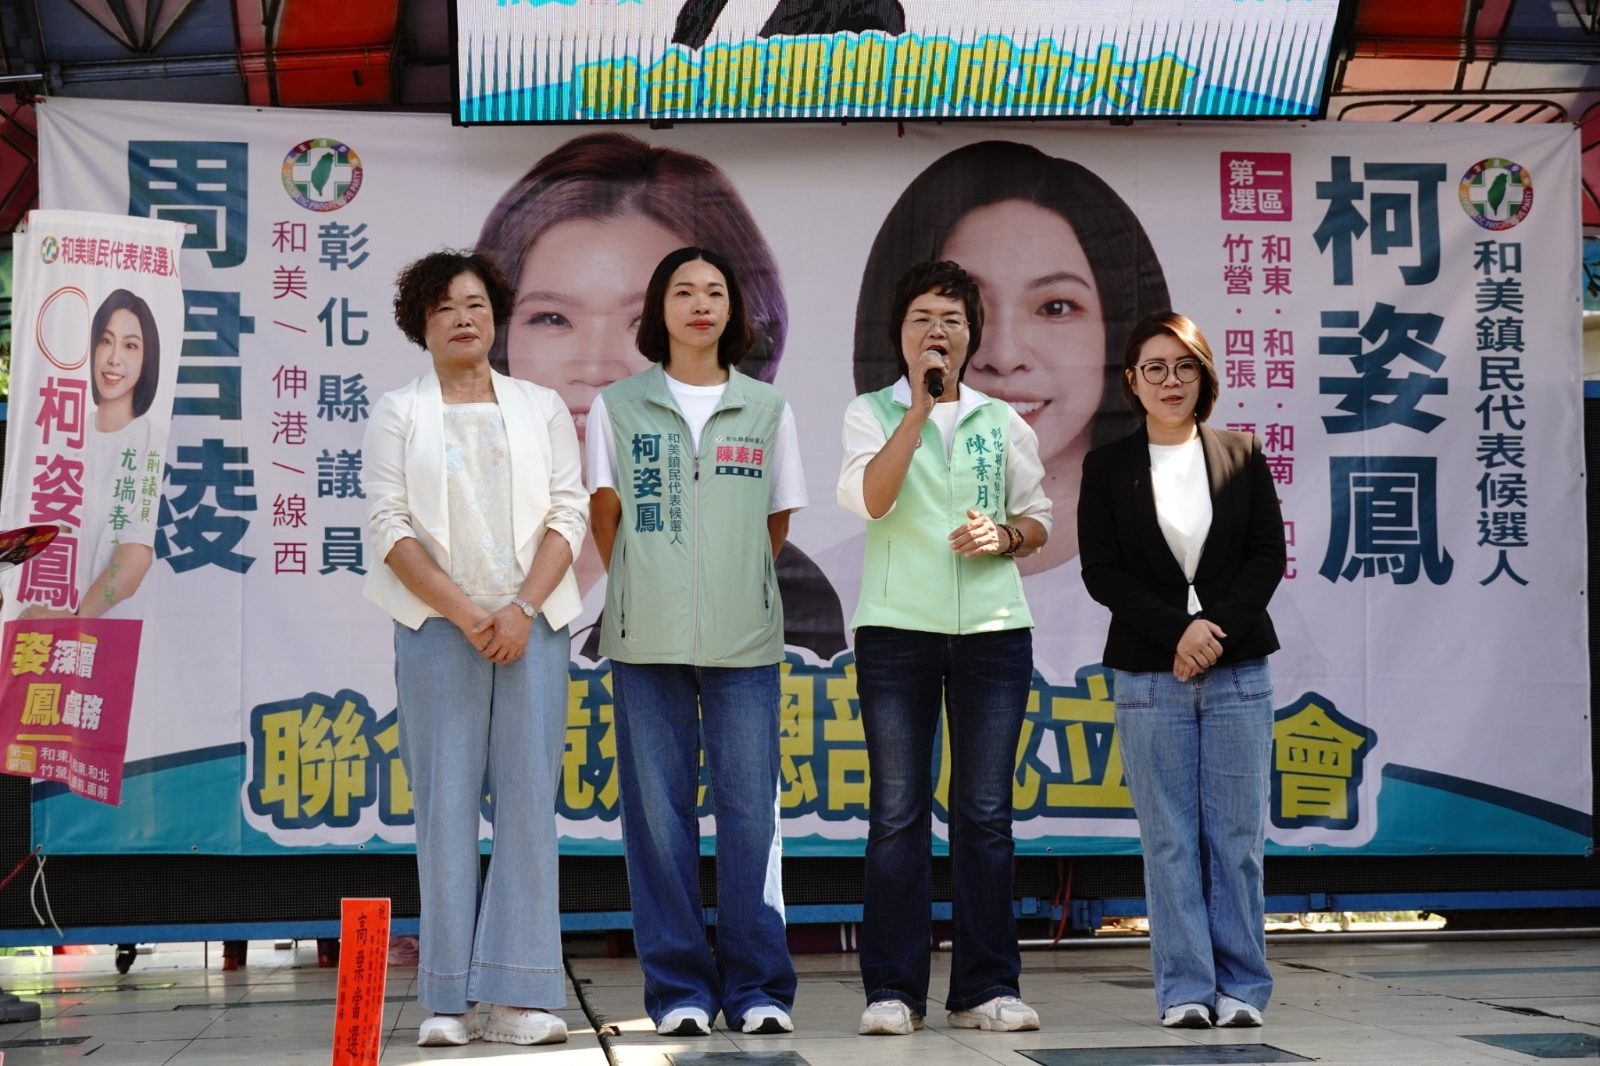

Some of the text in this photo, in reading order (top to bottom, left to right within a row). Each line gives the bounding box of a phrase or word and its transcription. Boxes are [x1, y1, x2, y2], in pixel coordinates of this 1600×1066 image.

[351, 170, 361, 192] PARTY
[1228, 159, 1285, 187] 第一
[1228, 188, 1285, 214] 選區
[61, 236, 179, 278] 和美鎮民代表候選人
[316, 221, 370, 576] 彰化縣議員
[1313, 156, 1455, 586] 柯姿鳳
[1473, 239, 1530, 587] 和美鎮民代表候選人
[17, 376, 89, 610] 柯姿鳳
[108, 448, 138, 531] 尤瑞春
[631, 433, 665, 534] 柯姿鳳
[667, 432, 683, 545] 和美鎮民代表候選人
[716, 444, 765, 466] 陳素月
[966, 433, 992, 509] 陳素月
